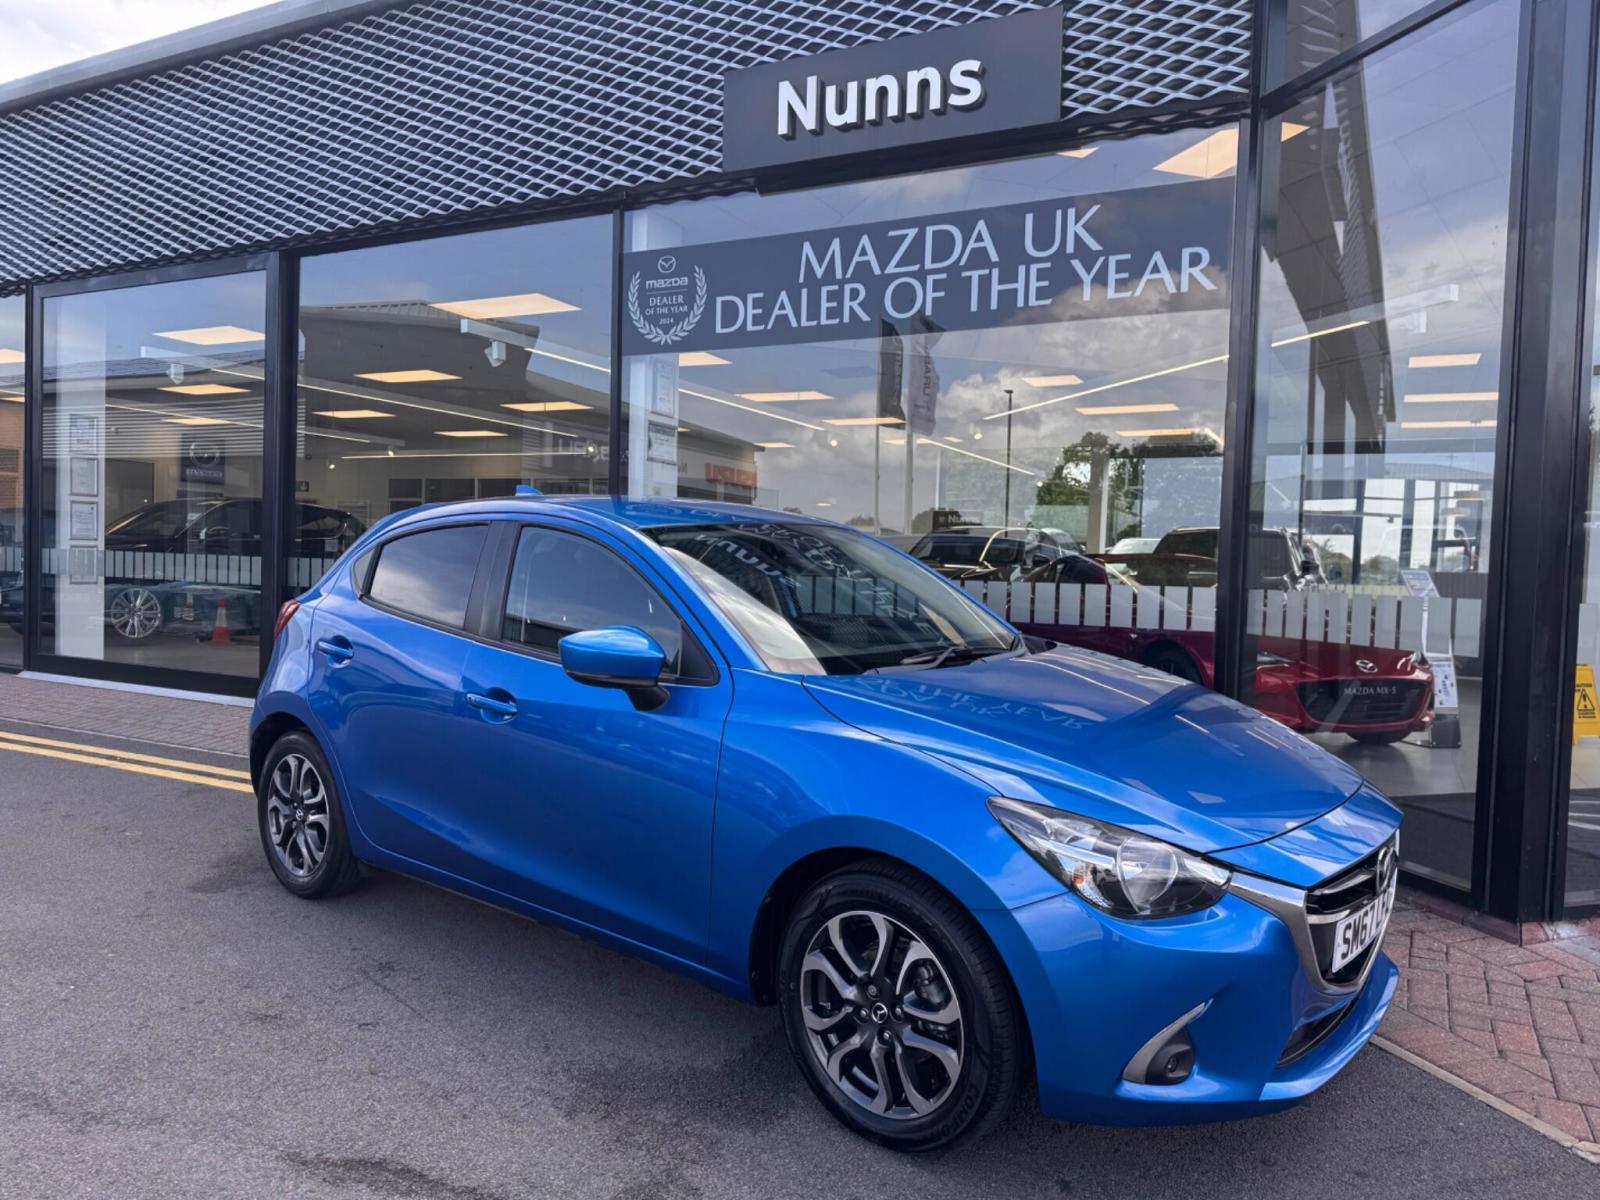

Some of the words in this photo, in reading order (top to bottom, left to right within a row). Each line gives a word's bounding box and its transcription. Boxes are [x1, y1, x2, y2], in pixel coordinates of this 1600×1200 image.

[777, 59, 985, 138] Nunns
[799, 219, 1000, 284] MAZDA
[1024, 204, 1103, 258] UK
[645, 307, 655, 316] OF
[656, 306, 669, 315] THE
[670, 304, 688, 314] YEAR
[649, 294, 685, 307] DEALER
[715, 282, 871, 333] DEALER
[884, 273, 948, 319] OF
[961, 262, 1053, 312] THE
[1070, 246, 1218, 302] YEAR
[1343, 686, 1375, 696] MAZDA
[1376, 685, 1398, 695] MX-5
